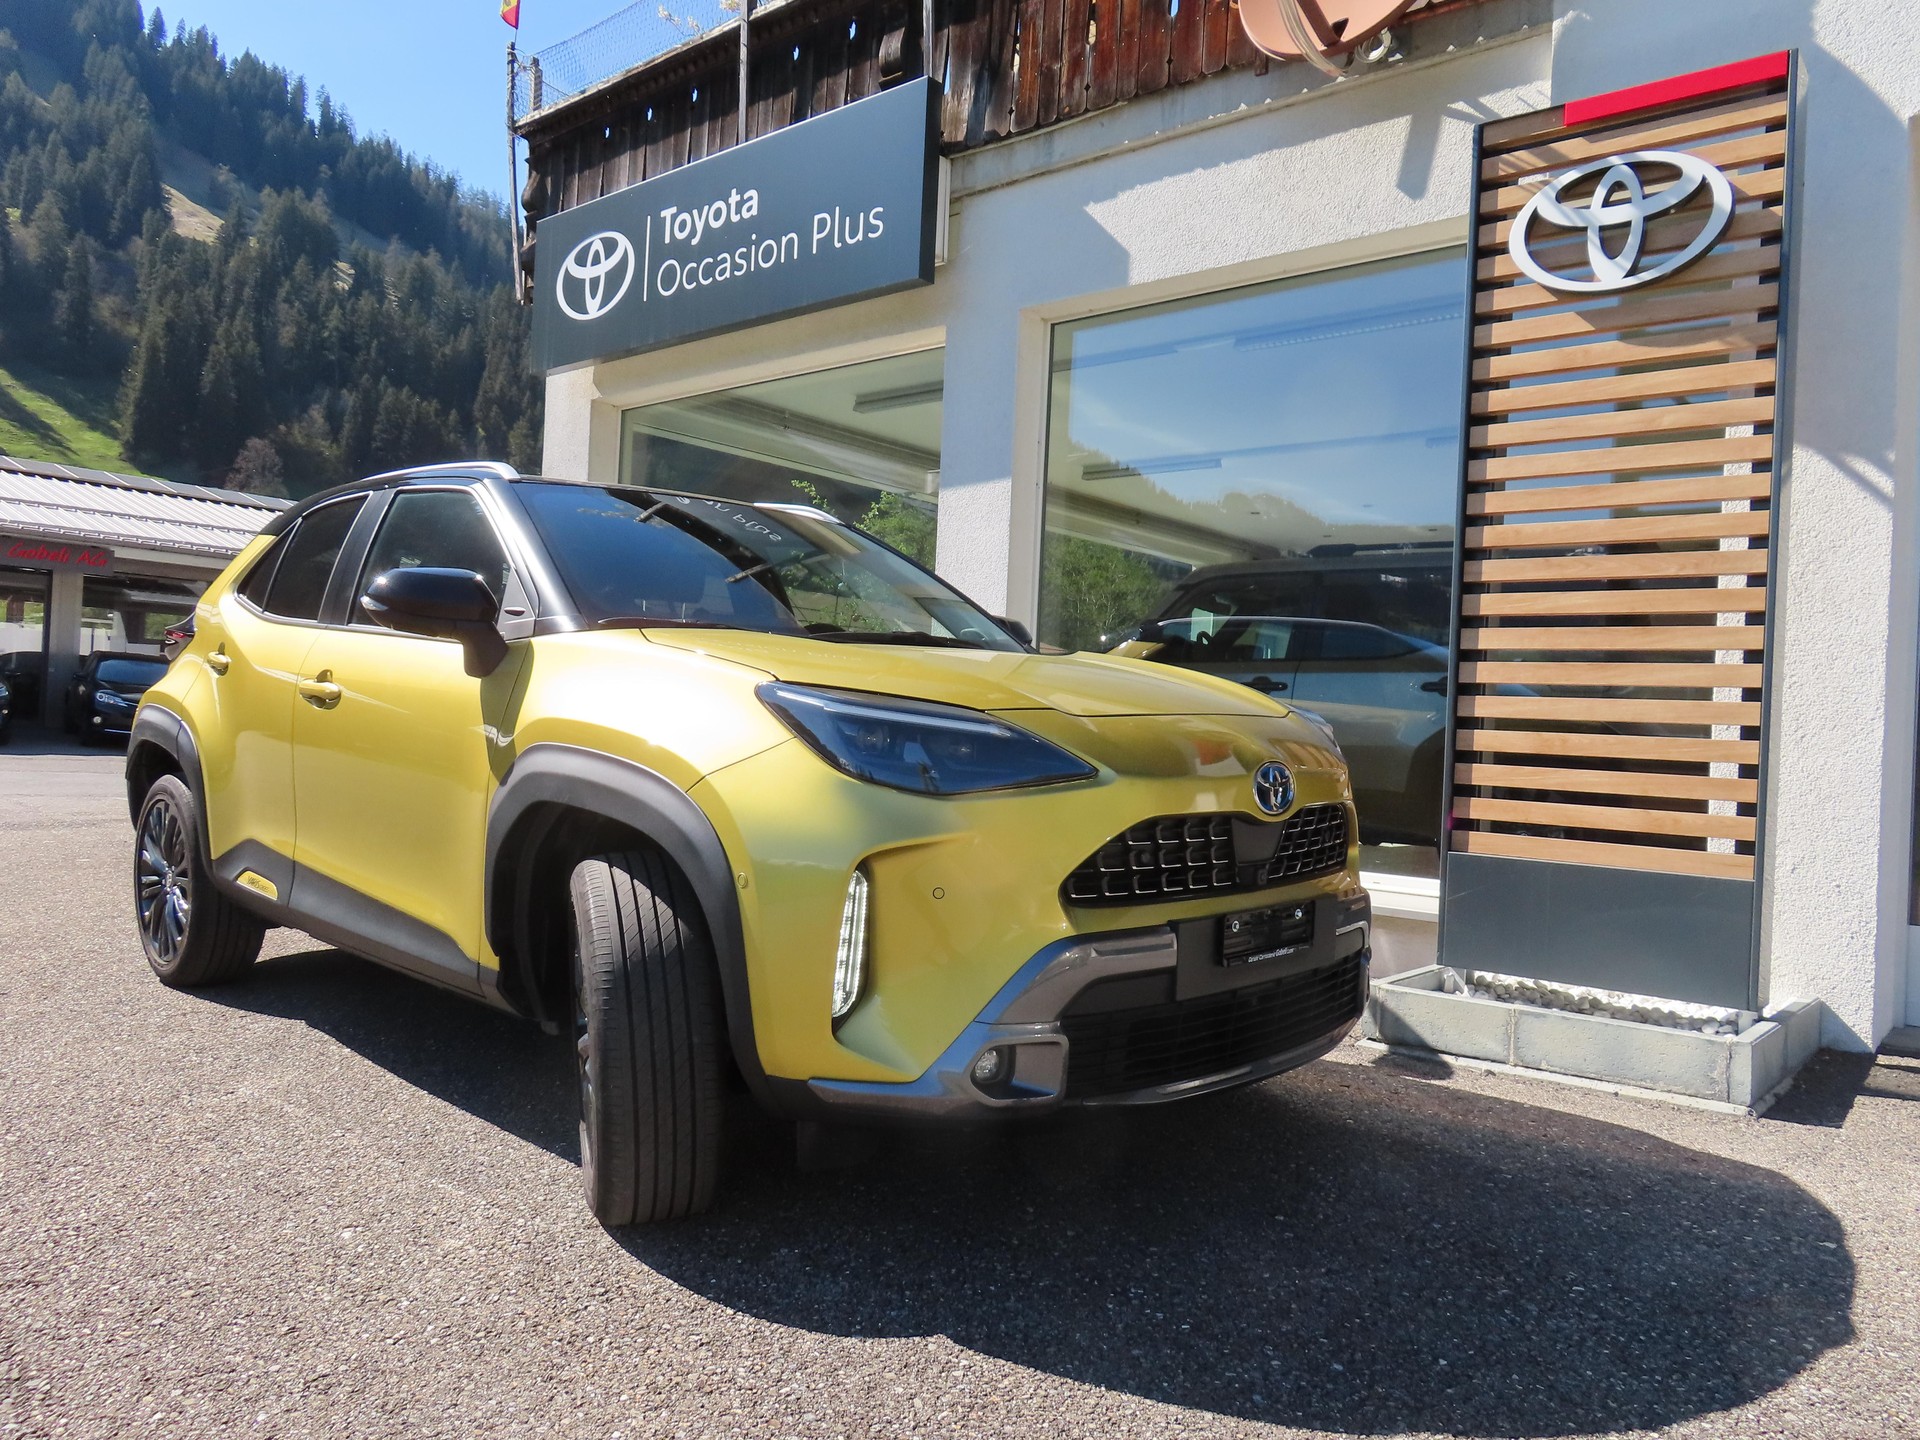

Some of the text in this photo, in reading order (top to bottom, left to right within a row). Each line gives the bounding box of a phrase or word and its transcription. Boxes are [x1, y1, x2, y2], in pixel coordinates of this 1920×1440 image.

[656, 206, 884, 297] Occasion Plus
[660, 188, 759, 245] Toyota
